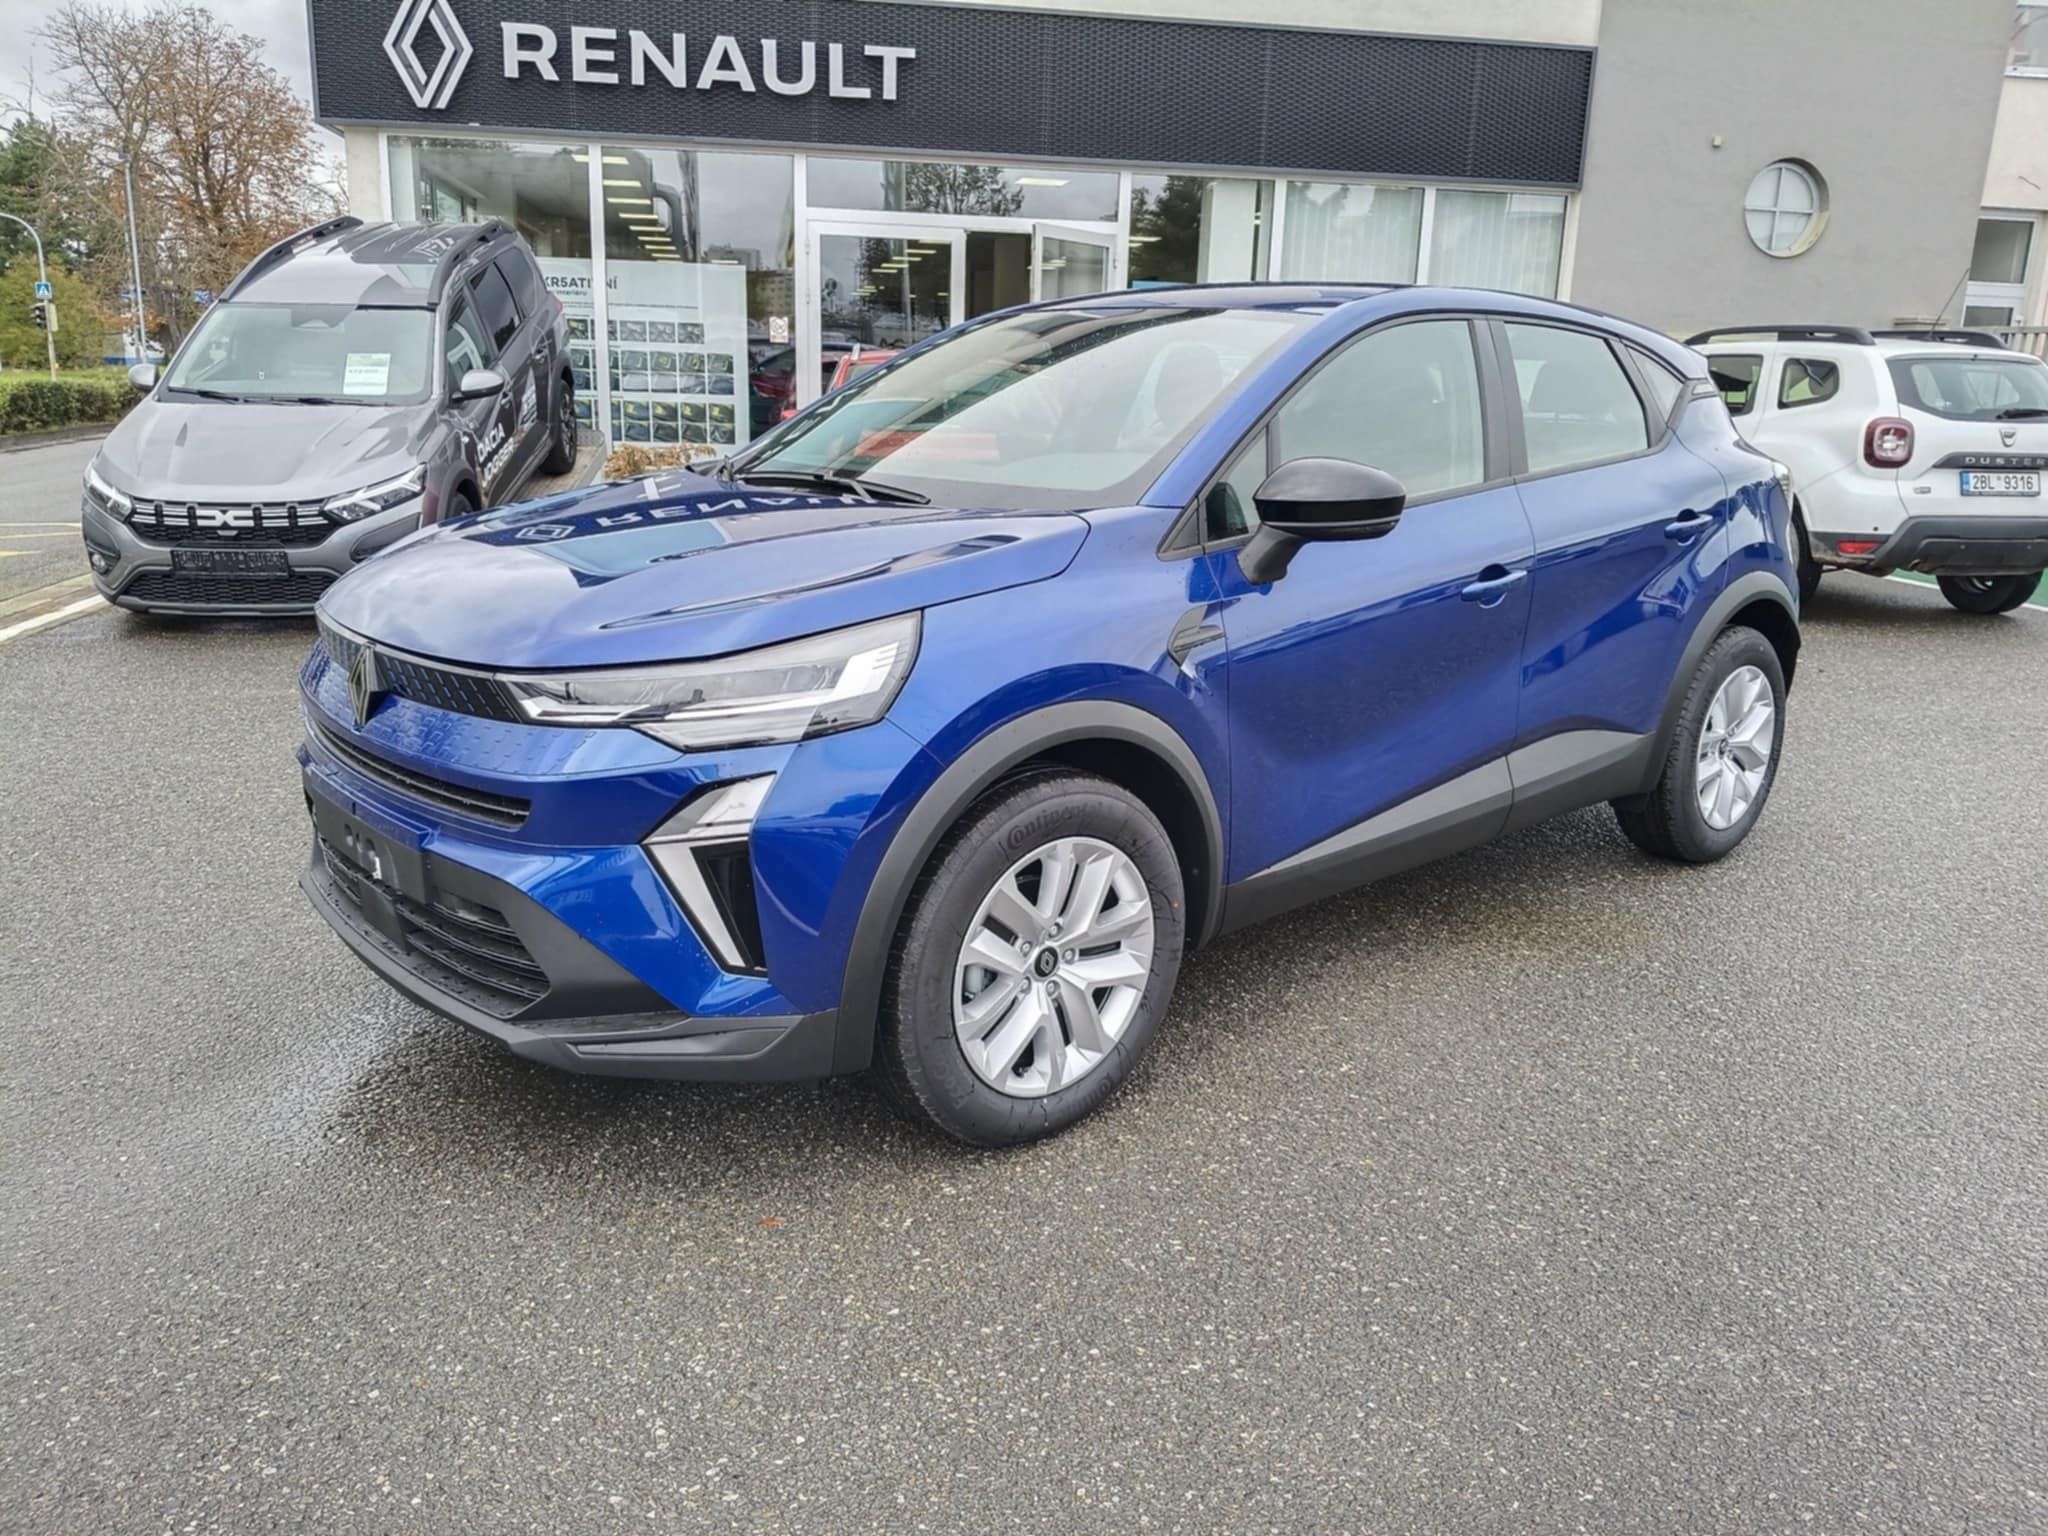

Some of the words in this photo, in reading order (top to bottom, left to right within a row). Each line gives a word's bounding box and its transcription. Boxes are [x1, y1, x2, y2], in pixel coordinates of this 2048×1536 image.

[500, 20, 917, 101] RENAULT
[477, 422, 506, 463] DACIA
[1965, 456, 2047, 465] DUSTER
[1972, 475, 1995, 490] 2BL
[2003, 475, 2034, 491] 9316
